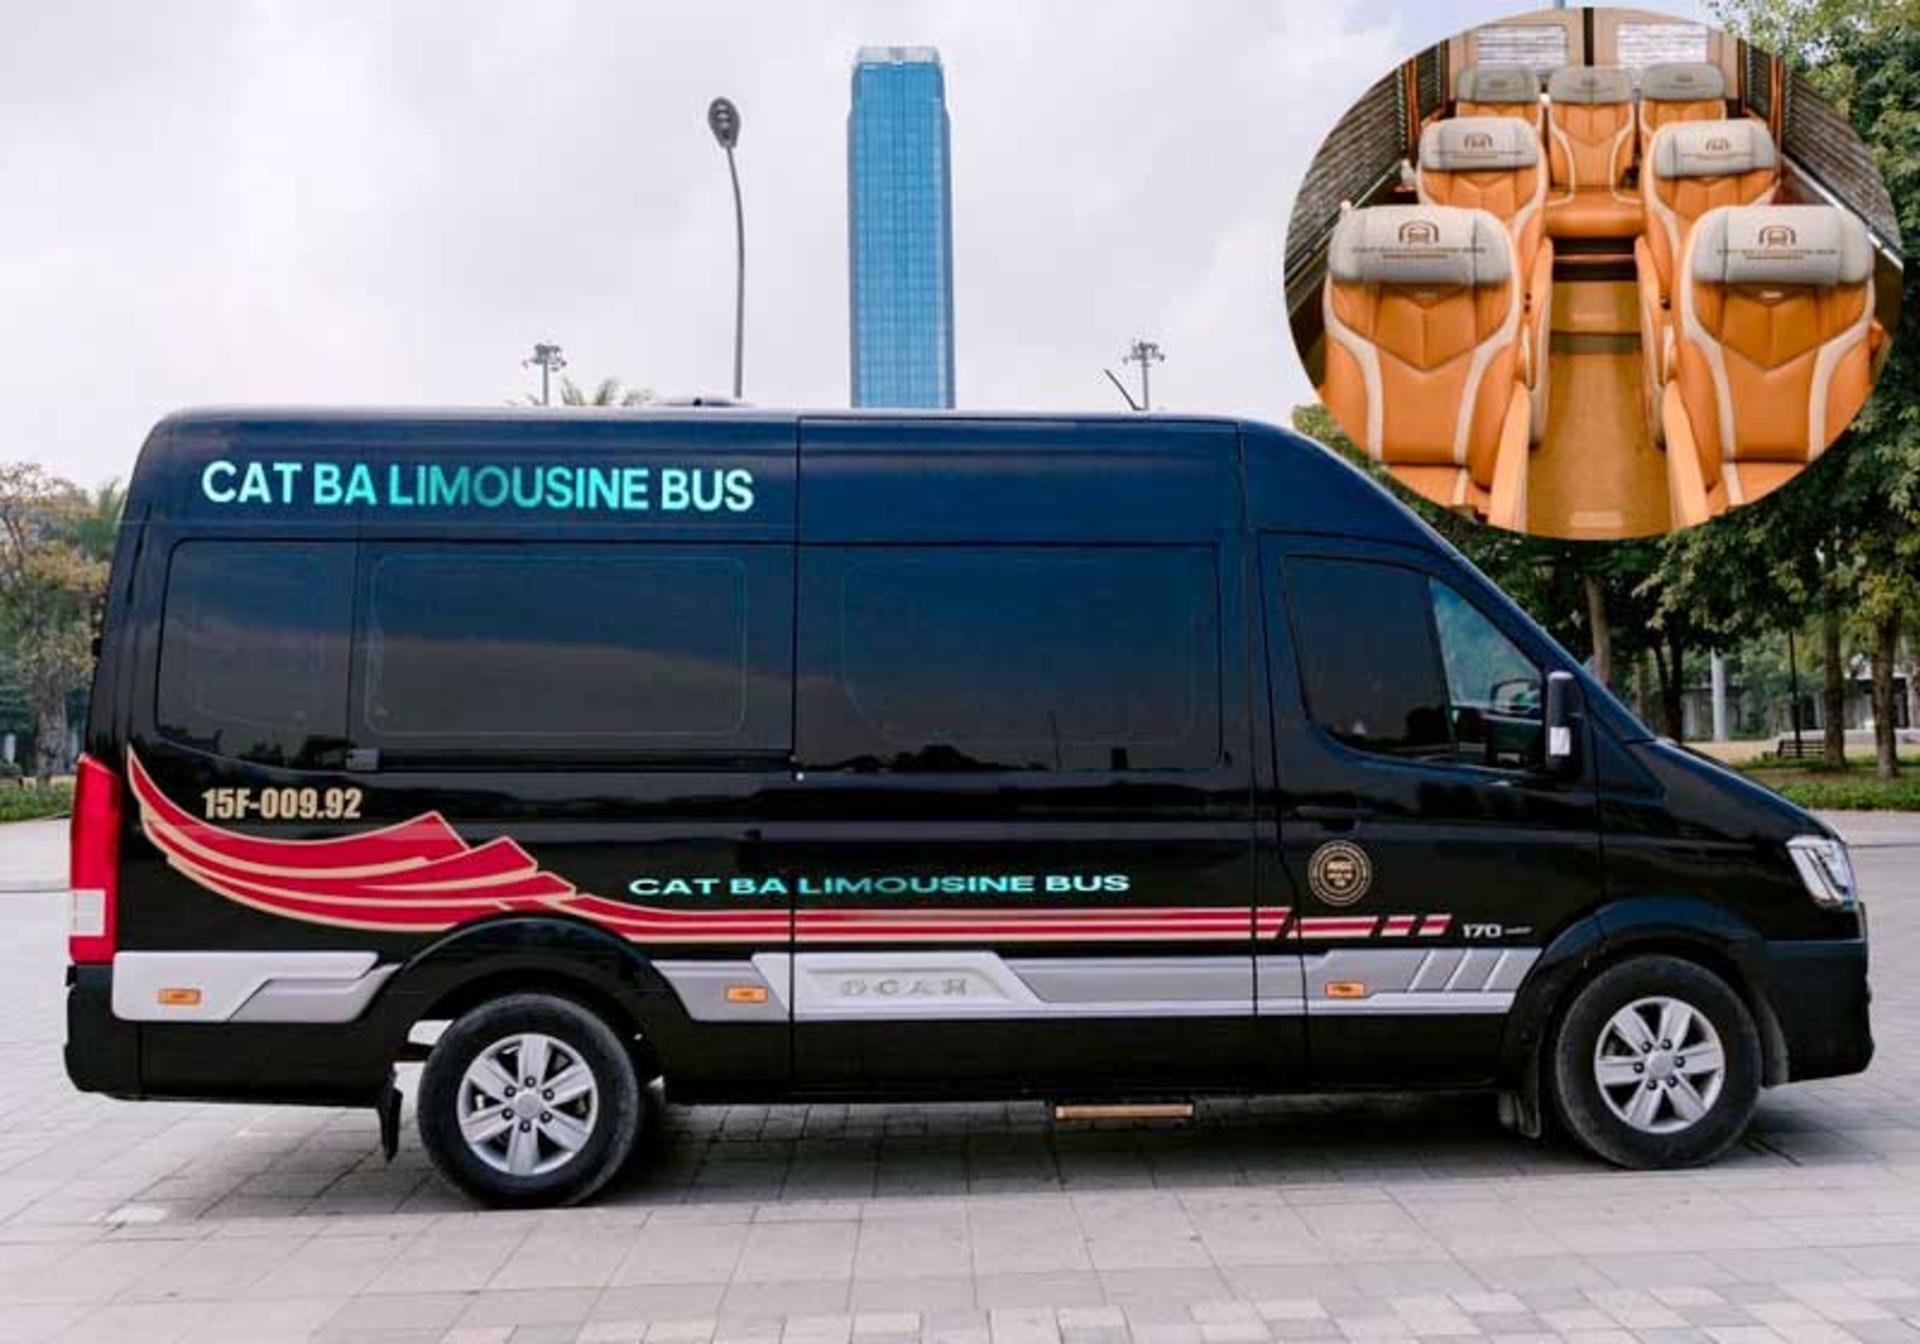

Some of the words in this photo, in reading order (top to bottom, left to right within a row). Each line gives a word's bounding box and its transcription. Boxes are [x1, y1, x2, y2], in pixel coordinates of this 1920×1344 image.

[202, 460, 303, 503] CAT
[313, 463, 378, 505] BA
[389, 464, 650, 510] LIMOUSINE
[661, 468, 754, 511] BUS
[201, 786, 363, 820] 15F-009.92
[629, 877, 720, 896] CAT
[729, 877, 788, 894] BA
[798, 875, 1035, 894] LIMOUSINE
[1045, 874, 1130, 892] BUS
[1462, 923, 1502, 939] 170
